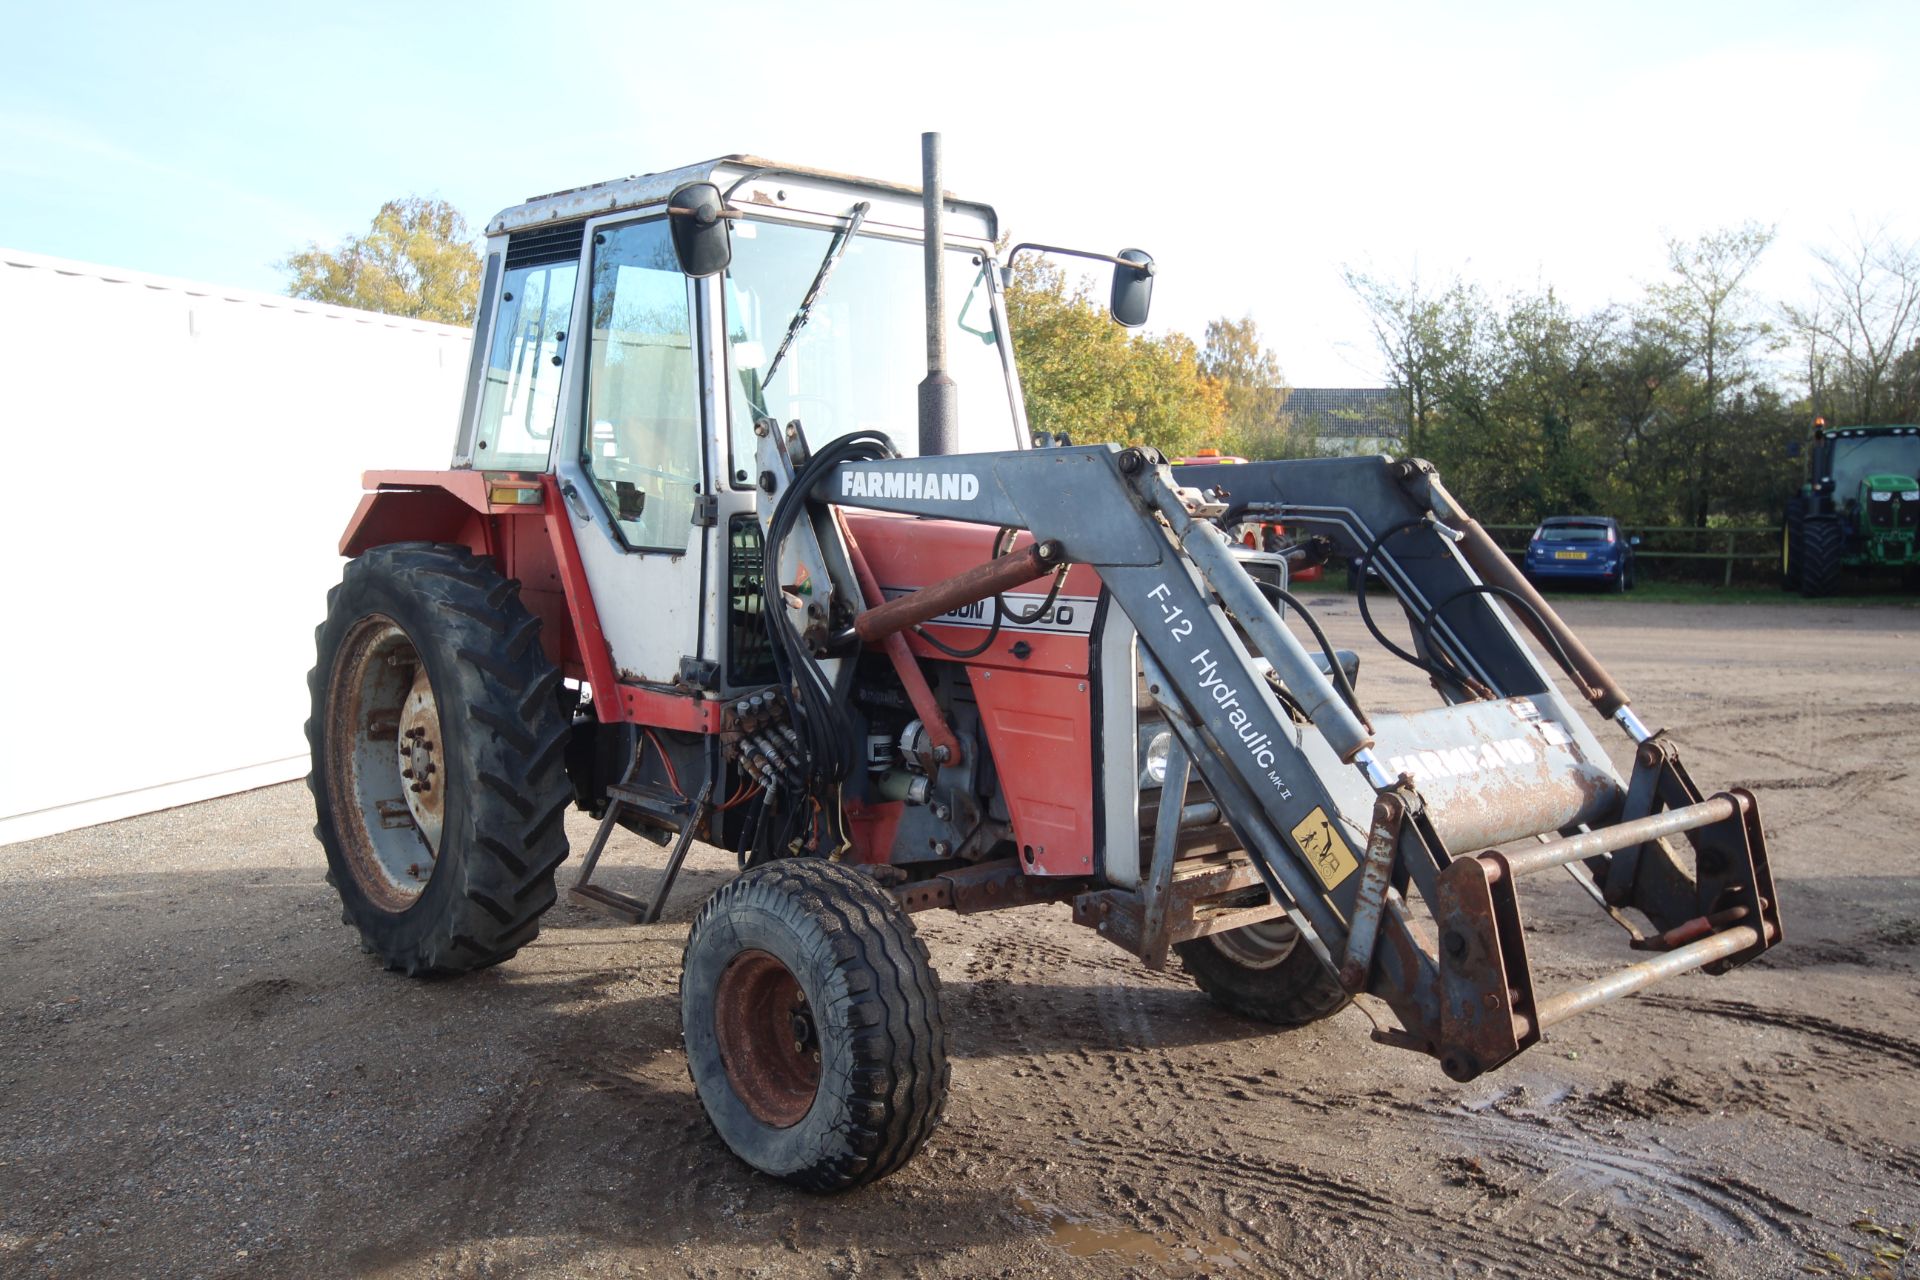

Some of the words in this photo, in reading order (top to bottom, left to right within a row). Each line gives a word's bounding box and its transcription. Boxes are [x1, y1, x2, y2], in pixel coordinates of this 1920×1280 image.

[841, 471, 980, 501] FARMHAND
[1147, 583, 1193, 643] F-12
[1190, 648, 1275, 769] Hydraulic
[1267, 770, 1285, 791] MK
[1280, 788, 1293, 801] II
